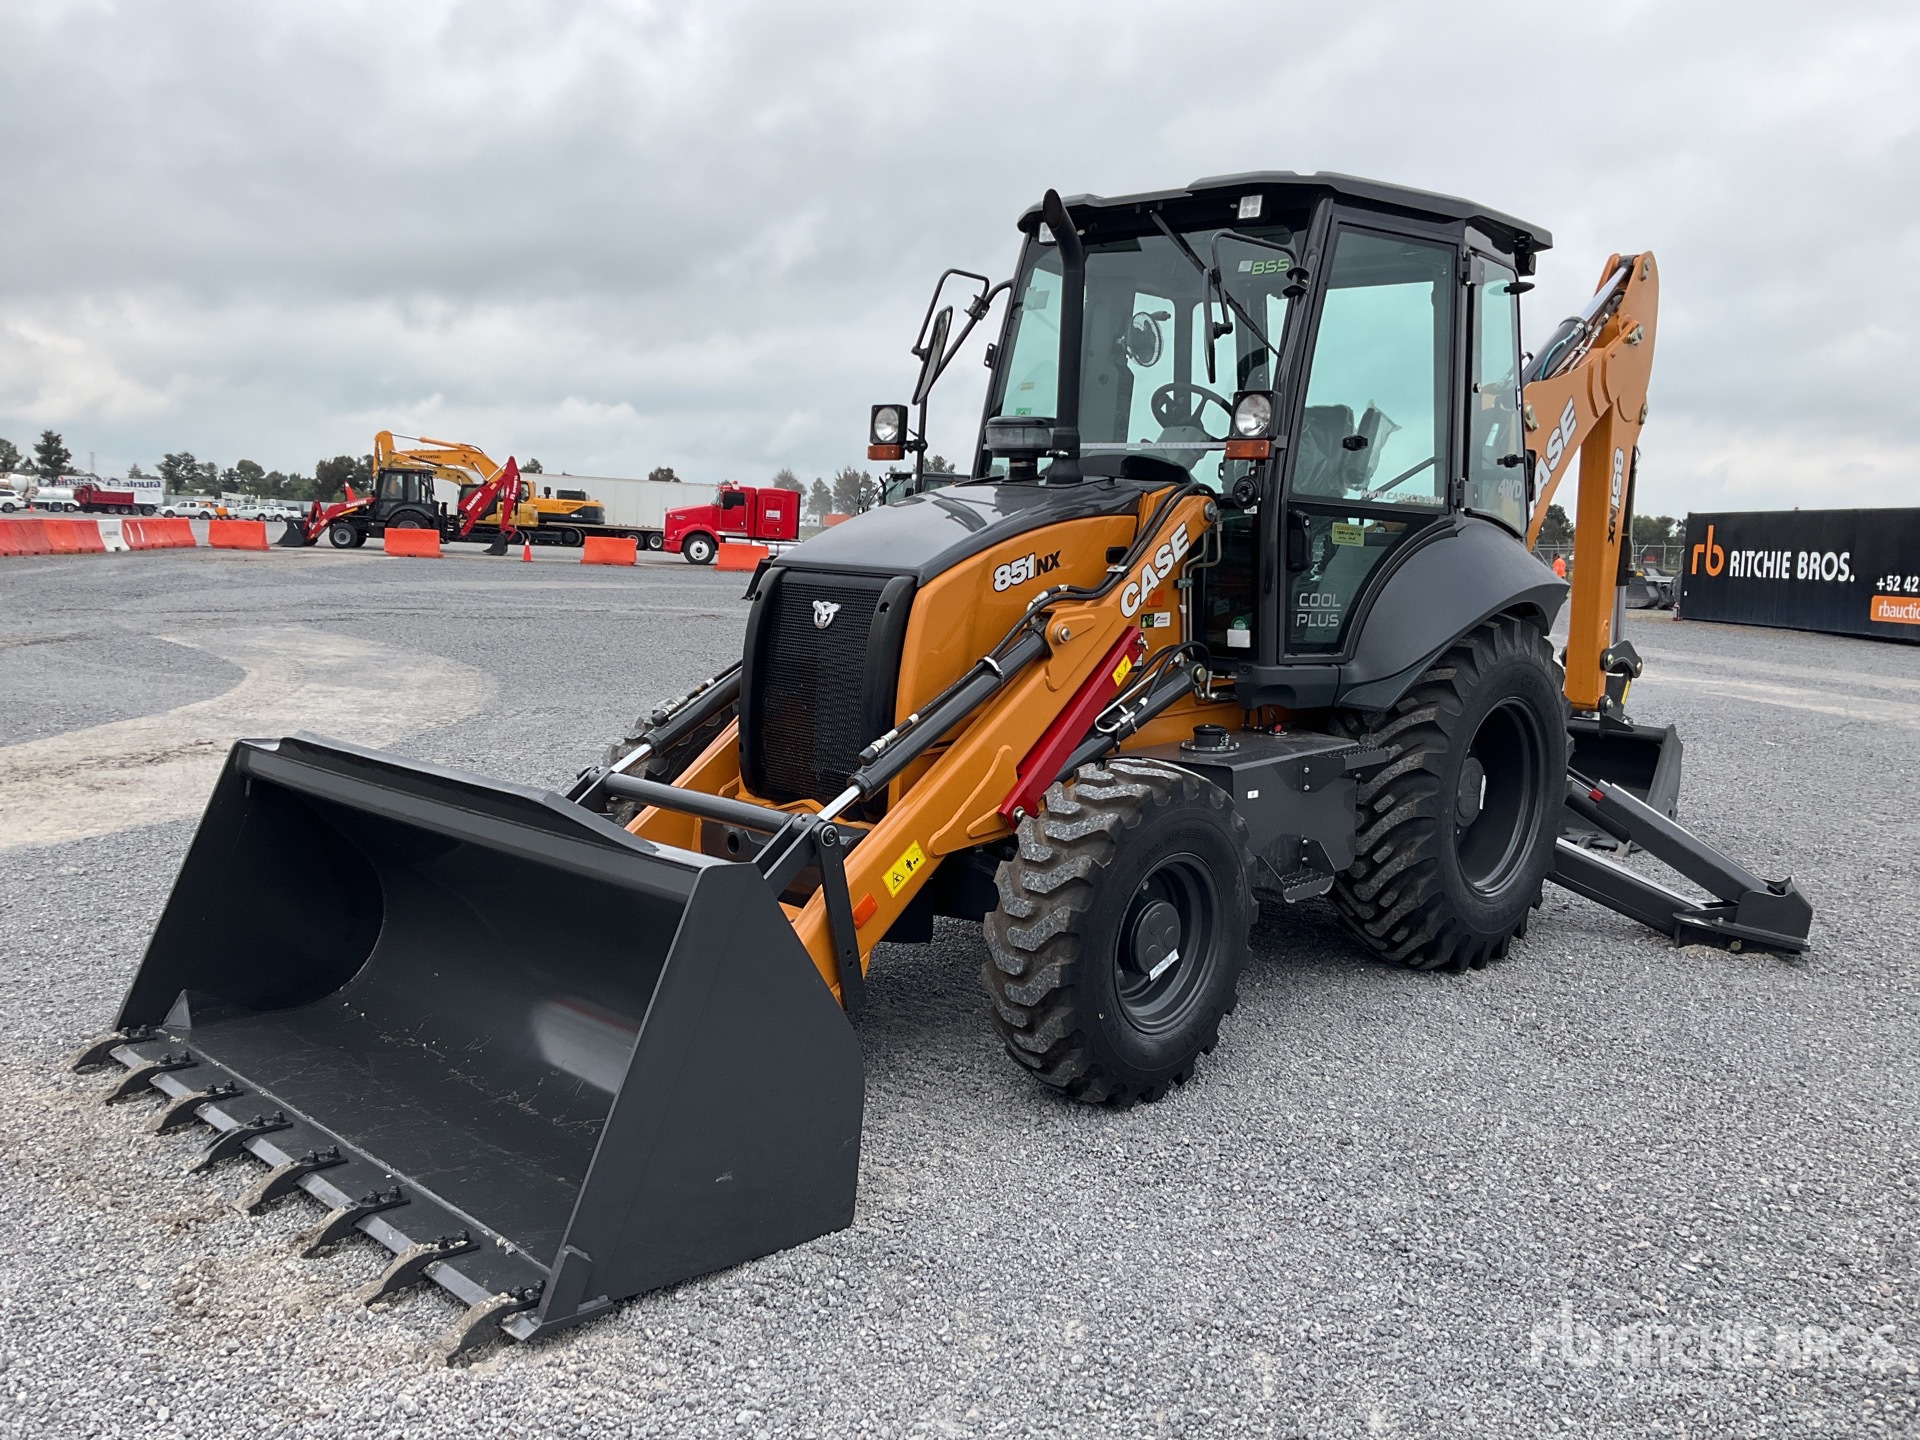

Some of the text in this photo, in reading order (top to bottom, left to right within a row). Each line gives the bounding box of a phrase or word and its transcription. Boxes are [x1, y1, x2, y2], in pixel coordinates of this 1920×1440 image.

[1529, 395, 1577, 522] ASE
[1120, 521, 1191, 618] CASE
[1691, 524, 1856, 583] rb RITCHIE BROS.
[1299, 592, 1341, 607] COOL
[1876, 575, 1901, 592] +52
[1296, 613, 1340, 627] PLUS
